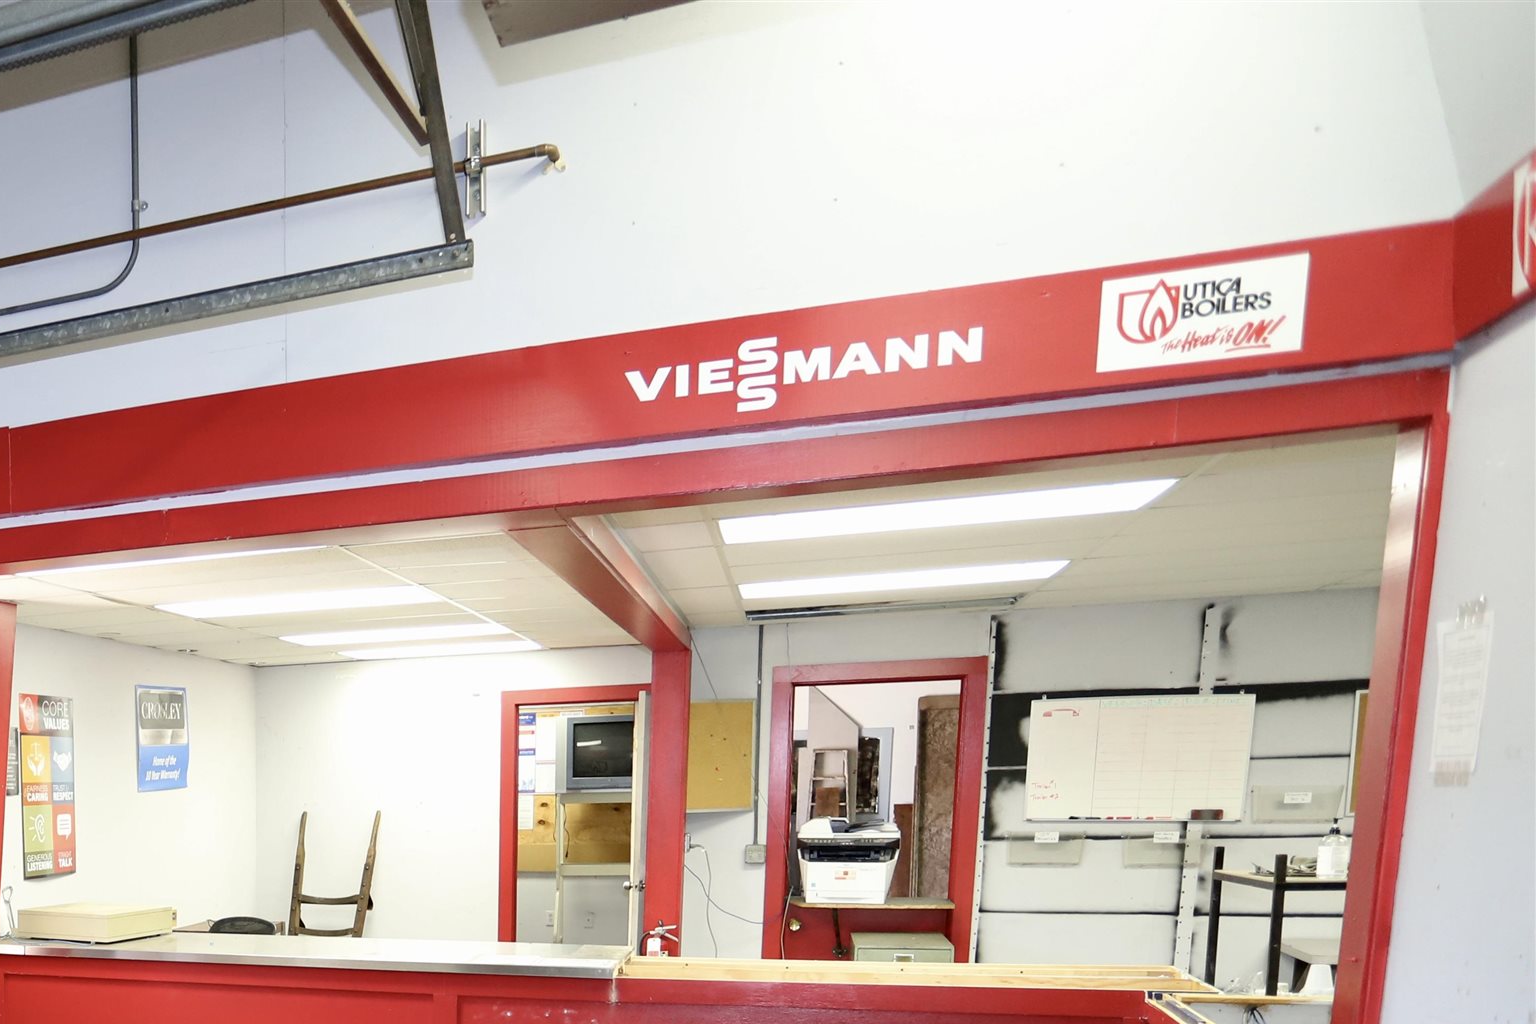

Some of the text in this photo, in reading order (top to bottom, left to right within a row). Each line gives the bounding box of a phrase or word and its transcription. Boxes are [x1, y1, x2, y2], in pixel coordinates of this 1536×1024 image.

[1183, 277, 1242, 301] UTICA
[1180, 291, 1272, 319] BOILERS
[1181, 327, 1221, 353] Heat
[42, 700, 68, 717] CORE
[141, 702, 181, 720] CROSLEY
[43, 717, 69, 730] VALUES
[152, 756, 164, 766] Home
[27, 792, 48, 802] CARING
[52, 791, 73, 801] RESPECT
[59, 857, 72, 868] TALK
